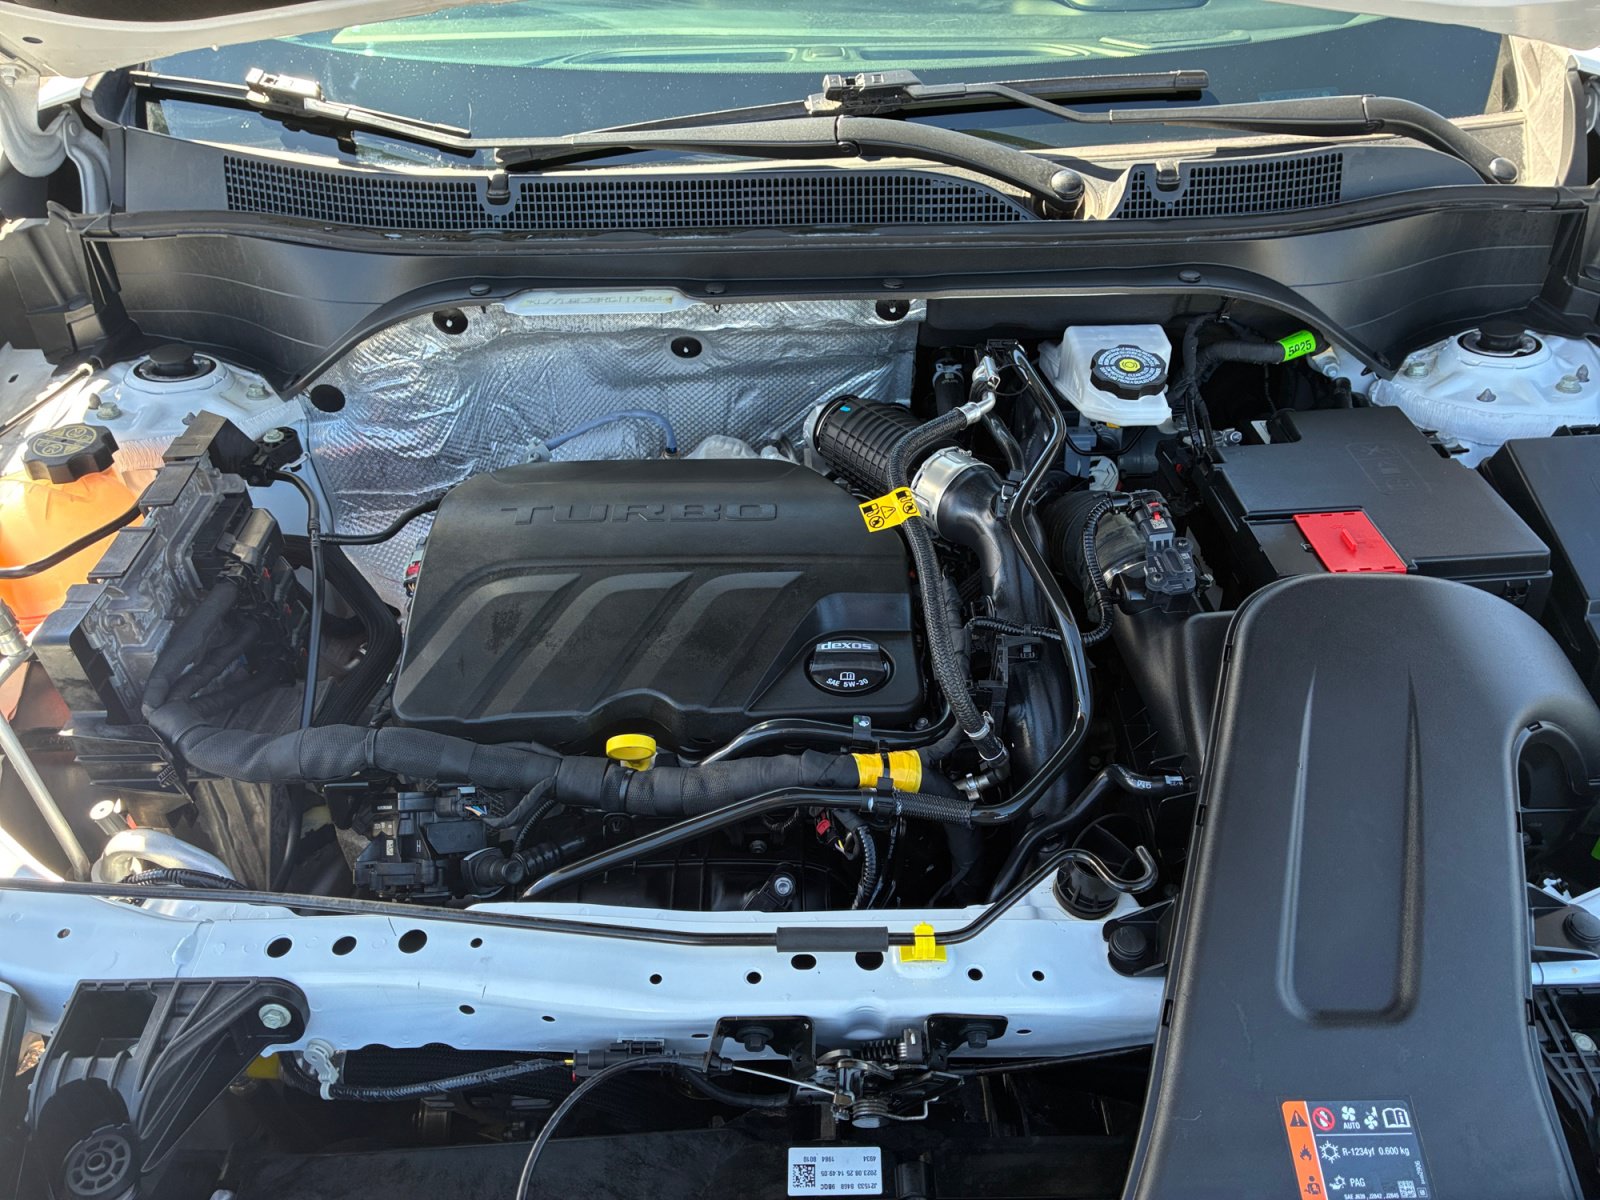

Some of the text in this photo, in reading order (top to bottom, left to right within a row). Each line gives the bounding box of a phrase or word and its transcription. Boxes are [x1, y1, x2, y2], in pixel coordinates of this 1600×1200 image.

[501, 504, 778, 524] TURBO
[821, 641, 872, 650] dexos
[826, 678, 869, 687] SAE 5W-30
[1342, 1147, 1410, 1157] R-1234yf 0.600 kg
[1350, 1178, 1366, 1187] PAG
